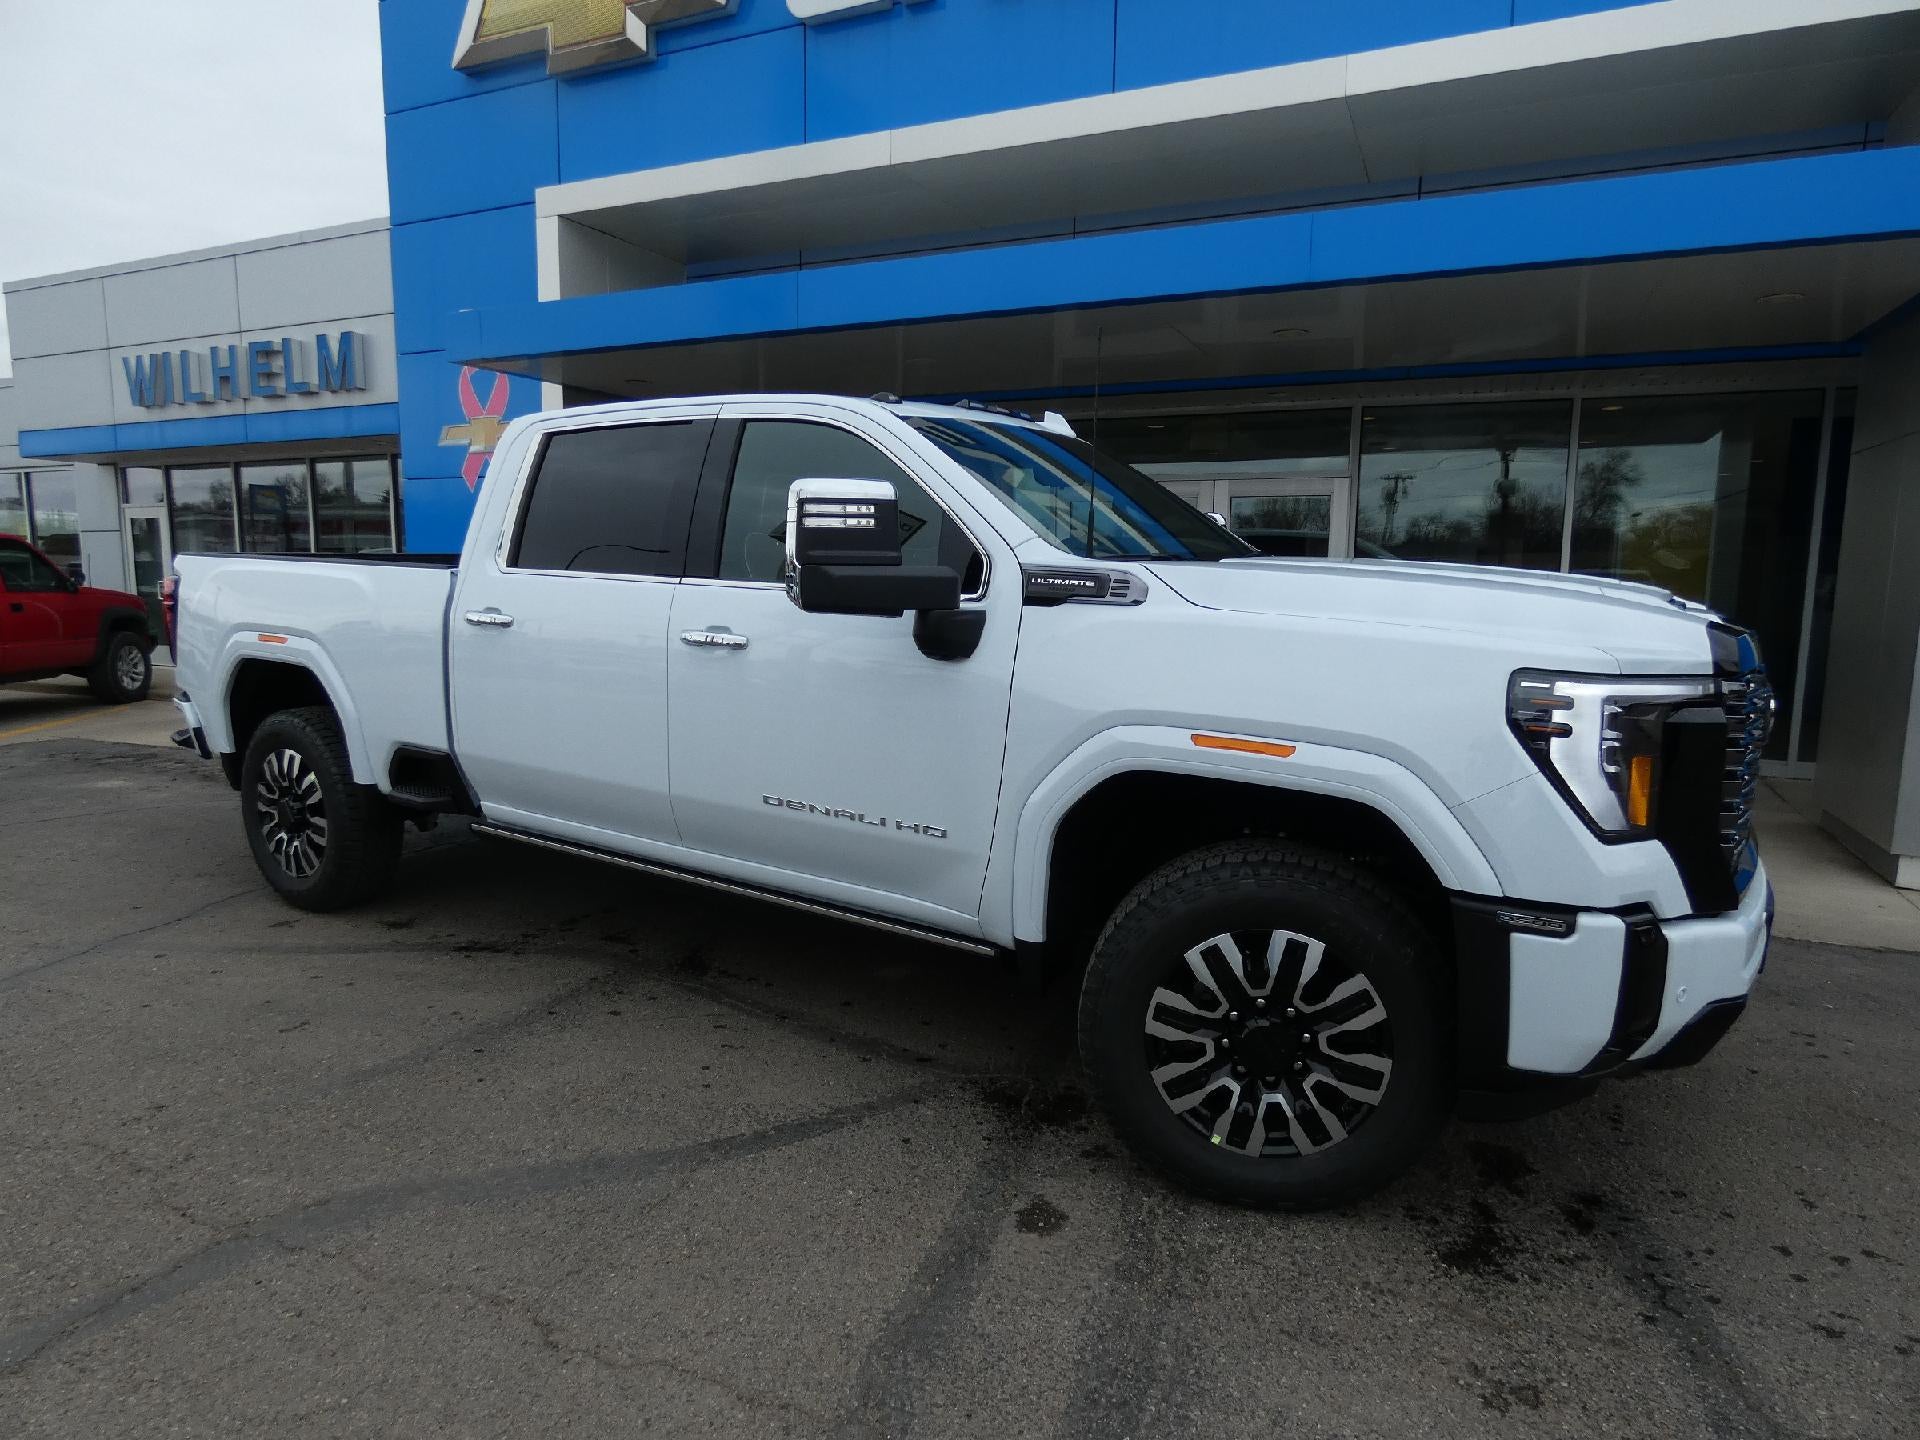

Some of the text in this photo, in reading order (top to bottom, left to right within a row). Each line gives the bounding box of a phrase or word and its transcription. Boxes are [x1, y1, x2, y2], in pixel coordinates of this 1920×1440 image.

[122, 331, 364, 408] WILHELM
[1031, 577, 1095, 587] ULTIMATE
[762, 793, 948, 839] DENALI HD
